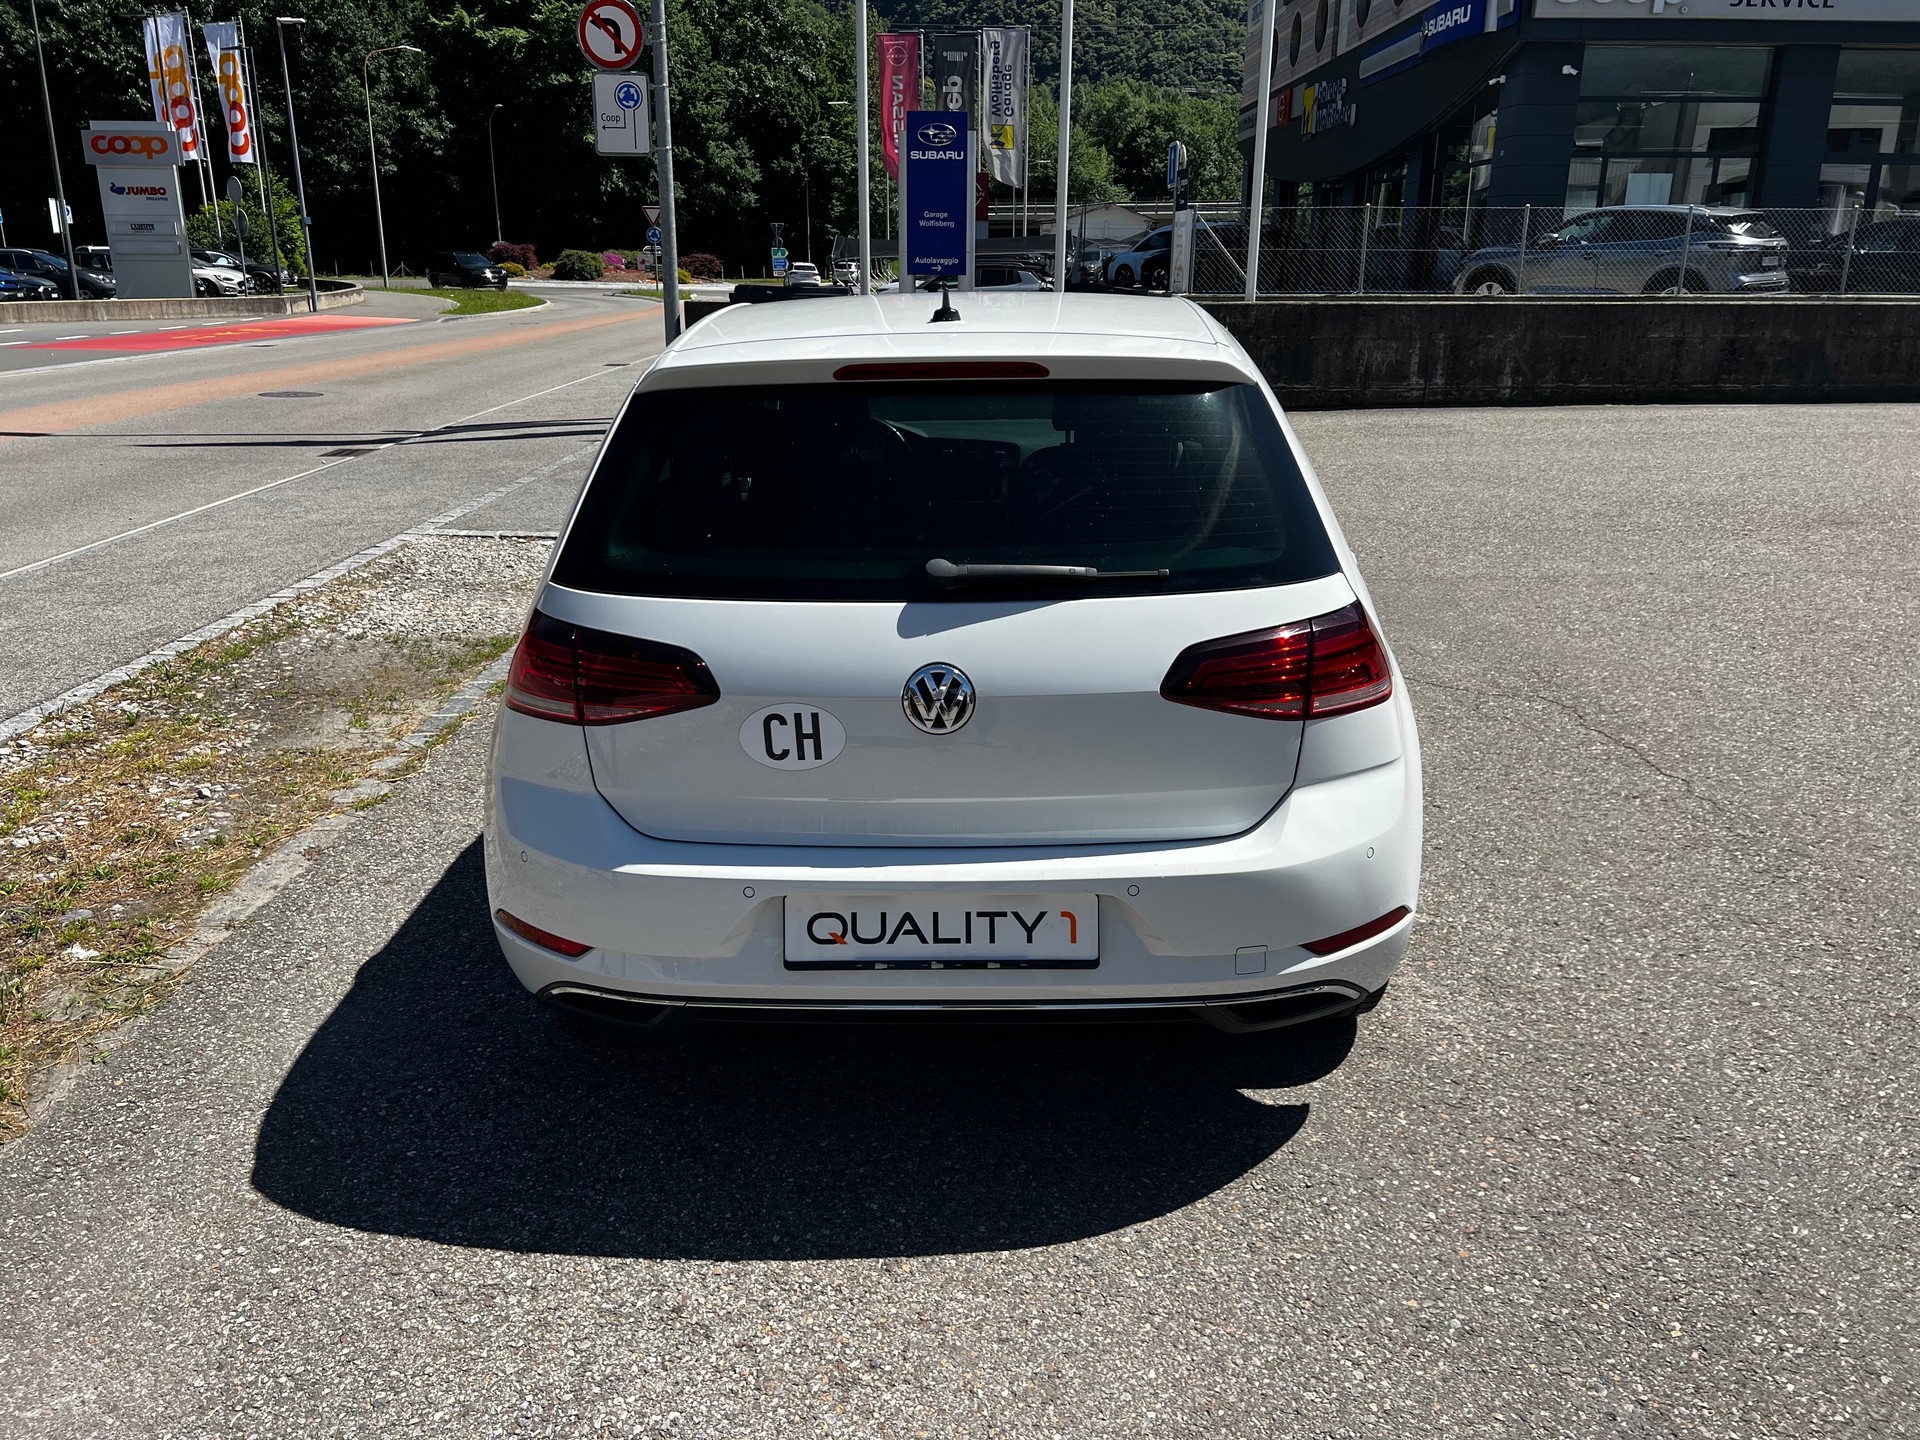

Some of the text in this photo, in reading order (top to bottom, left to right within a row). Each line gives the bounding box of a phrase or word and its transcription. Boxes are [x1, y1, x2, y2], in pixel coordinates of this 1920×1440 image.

[1428, 4, 1471, 37] SUBARU
[601, 112, 621, 124] Coop
[90, 135, 169, 160] coop
[910, 151, 964, 160] SUBARU
[125, 186, 167, 196] JUMBO
[923, 211, 948, 219] Garage
[919, 220, 955, 229] Wolfisberg
[914, 257, 959, 266] Autolavaggio
[763, 712, 823, 761] CH
[806, 911, 1077, 945] QUALITY 1
